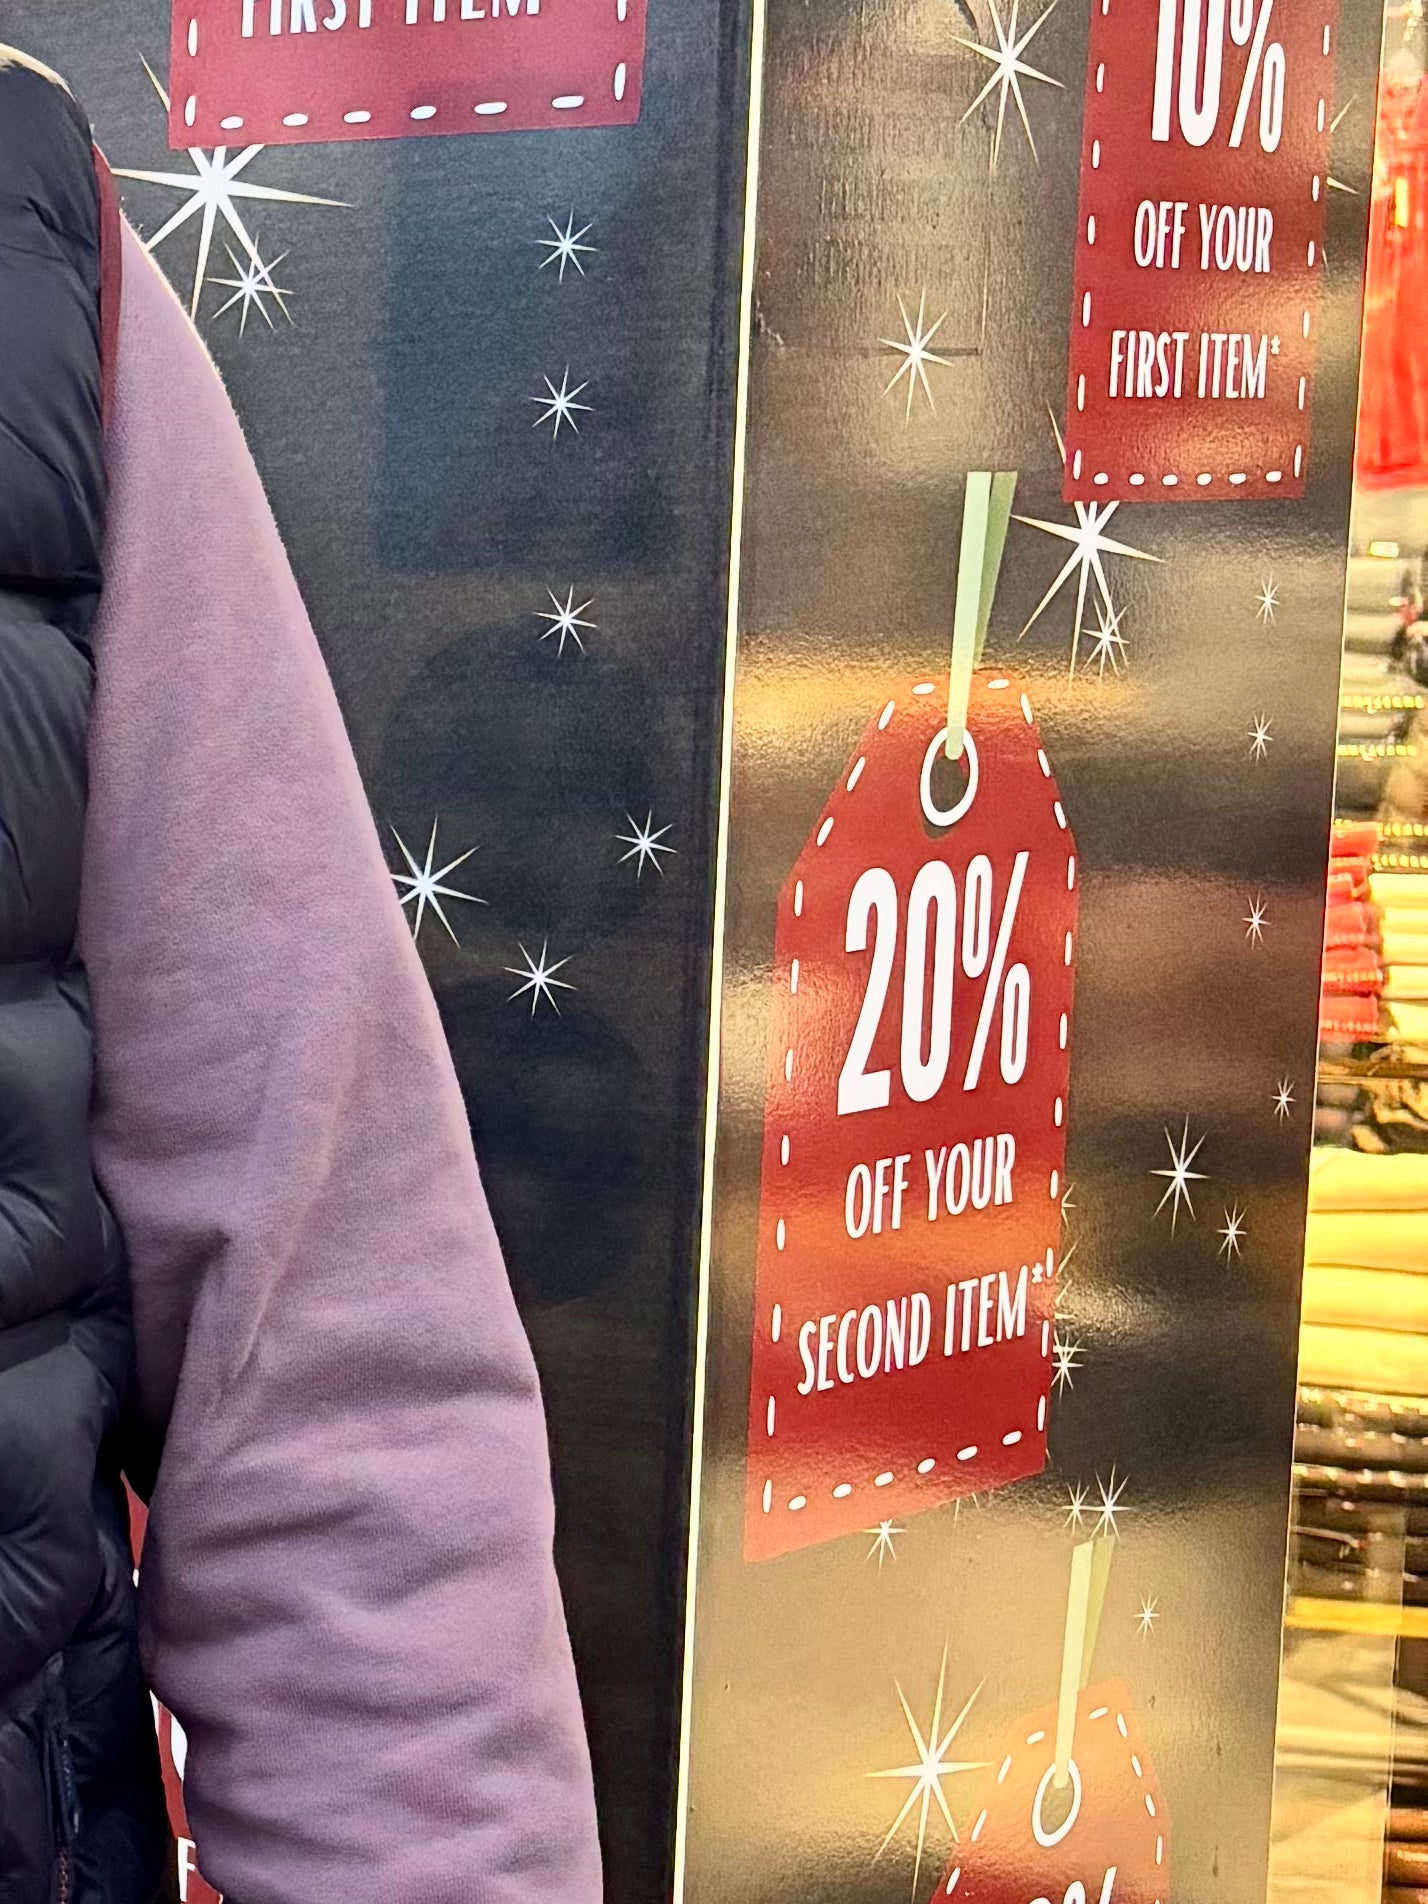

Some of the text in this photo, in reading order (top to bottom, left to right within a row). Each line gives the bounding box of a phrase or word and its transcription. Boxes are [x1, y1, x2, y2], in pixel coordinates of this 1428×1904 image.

[1134, 199, 1273, 273] OFF YOUR
[1109, 329, 1191, 399] FIRST
[837, 850, 1030, 1115] 20%
[844, 1133, 1017, 1240] OFF YOUR
[797, 1292, 931, 1396] SECOND
